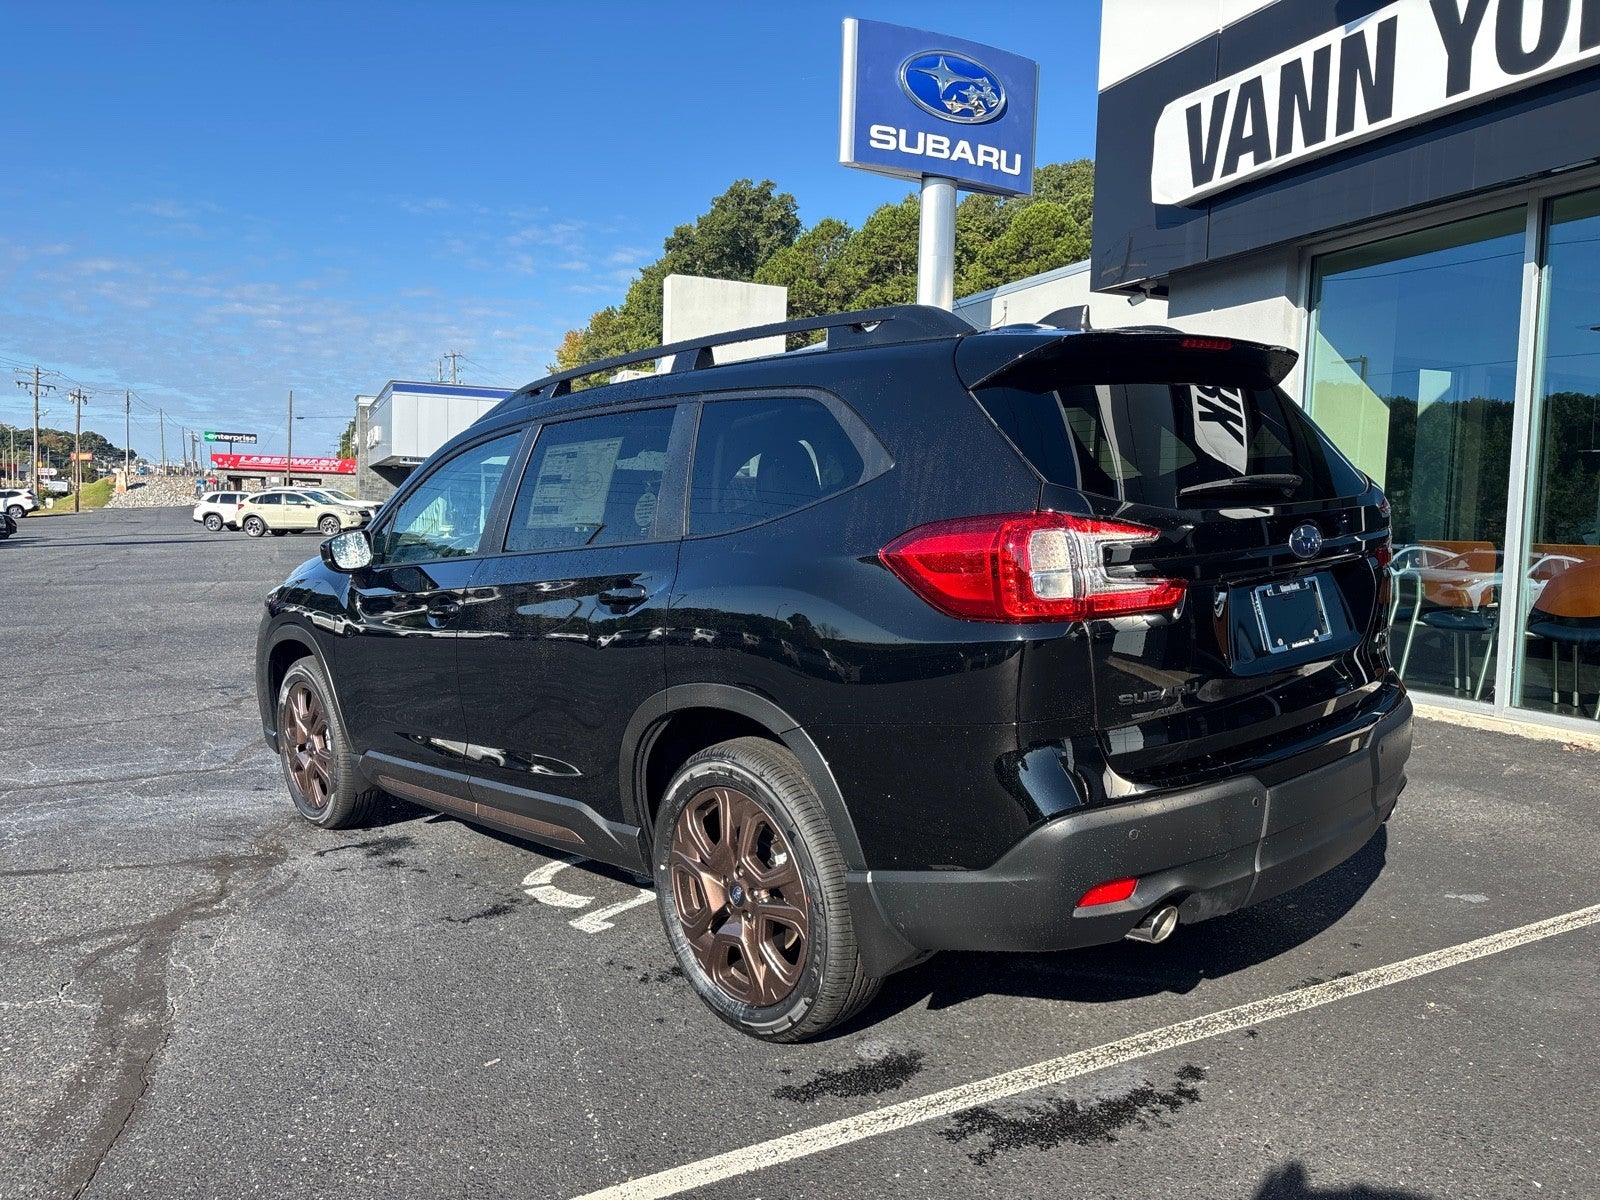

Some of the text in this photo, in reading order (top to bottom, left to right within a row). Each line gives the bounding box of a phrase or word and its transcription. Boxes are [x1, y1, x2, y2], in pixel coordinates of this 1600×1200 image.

[1185, 0, 1600, 188] VANN YO
[869, 124, 1022, 176] SUBARU
[206, 433, 256, 442] enterprise
[1118, 682, 1200, 706] SUBARU
